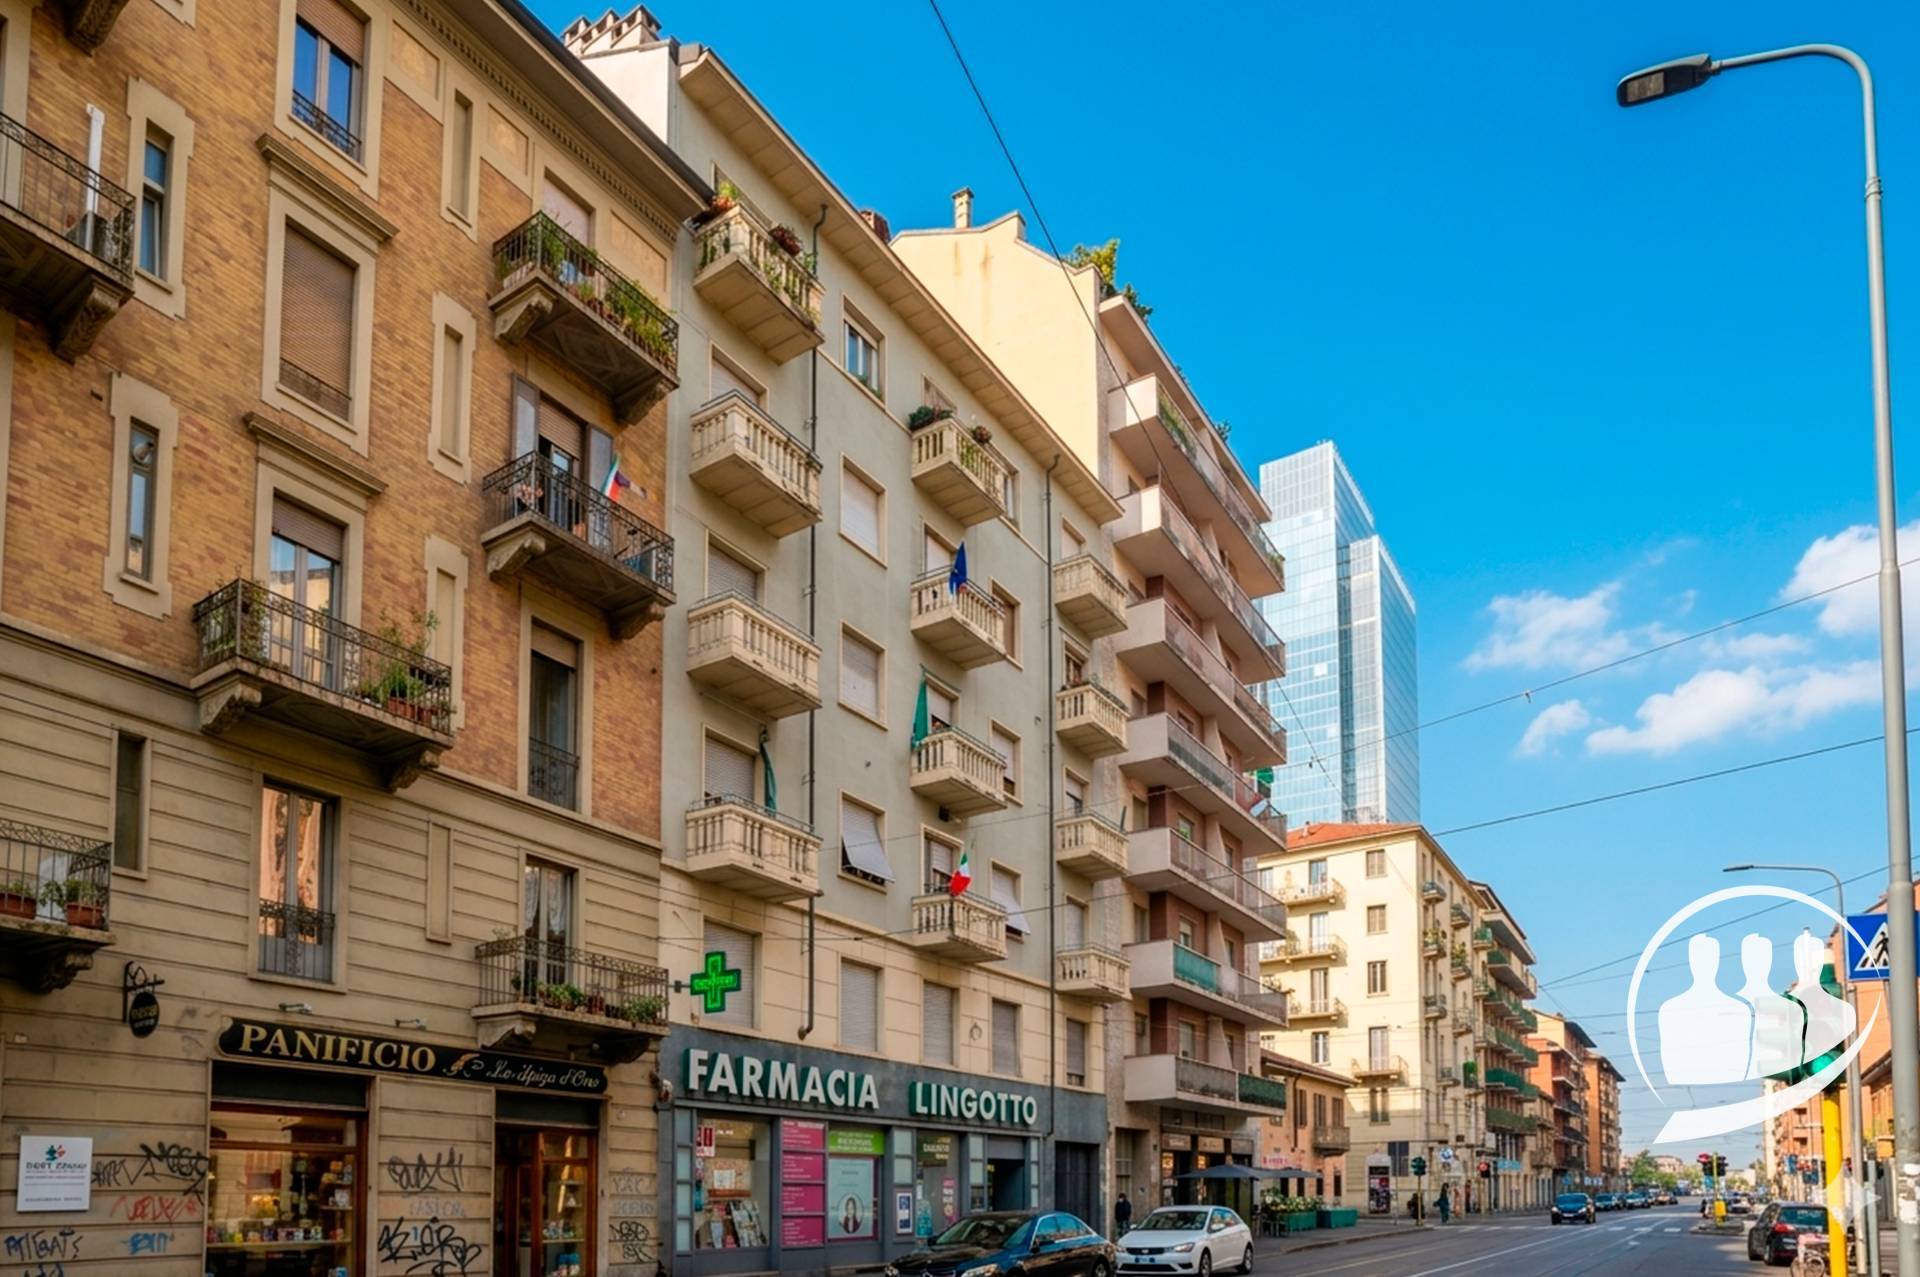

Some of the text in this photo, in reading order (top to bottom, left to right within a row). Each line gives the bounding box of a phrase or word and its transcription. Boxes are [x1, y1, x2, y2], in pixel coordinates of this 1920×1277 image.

[239, 1024, 436, 1072] PANIFICIO
[685, 1048, 1038, 1125] FARMACIA LINGOTTO
